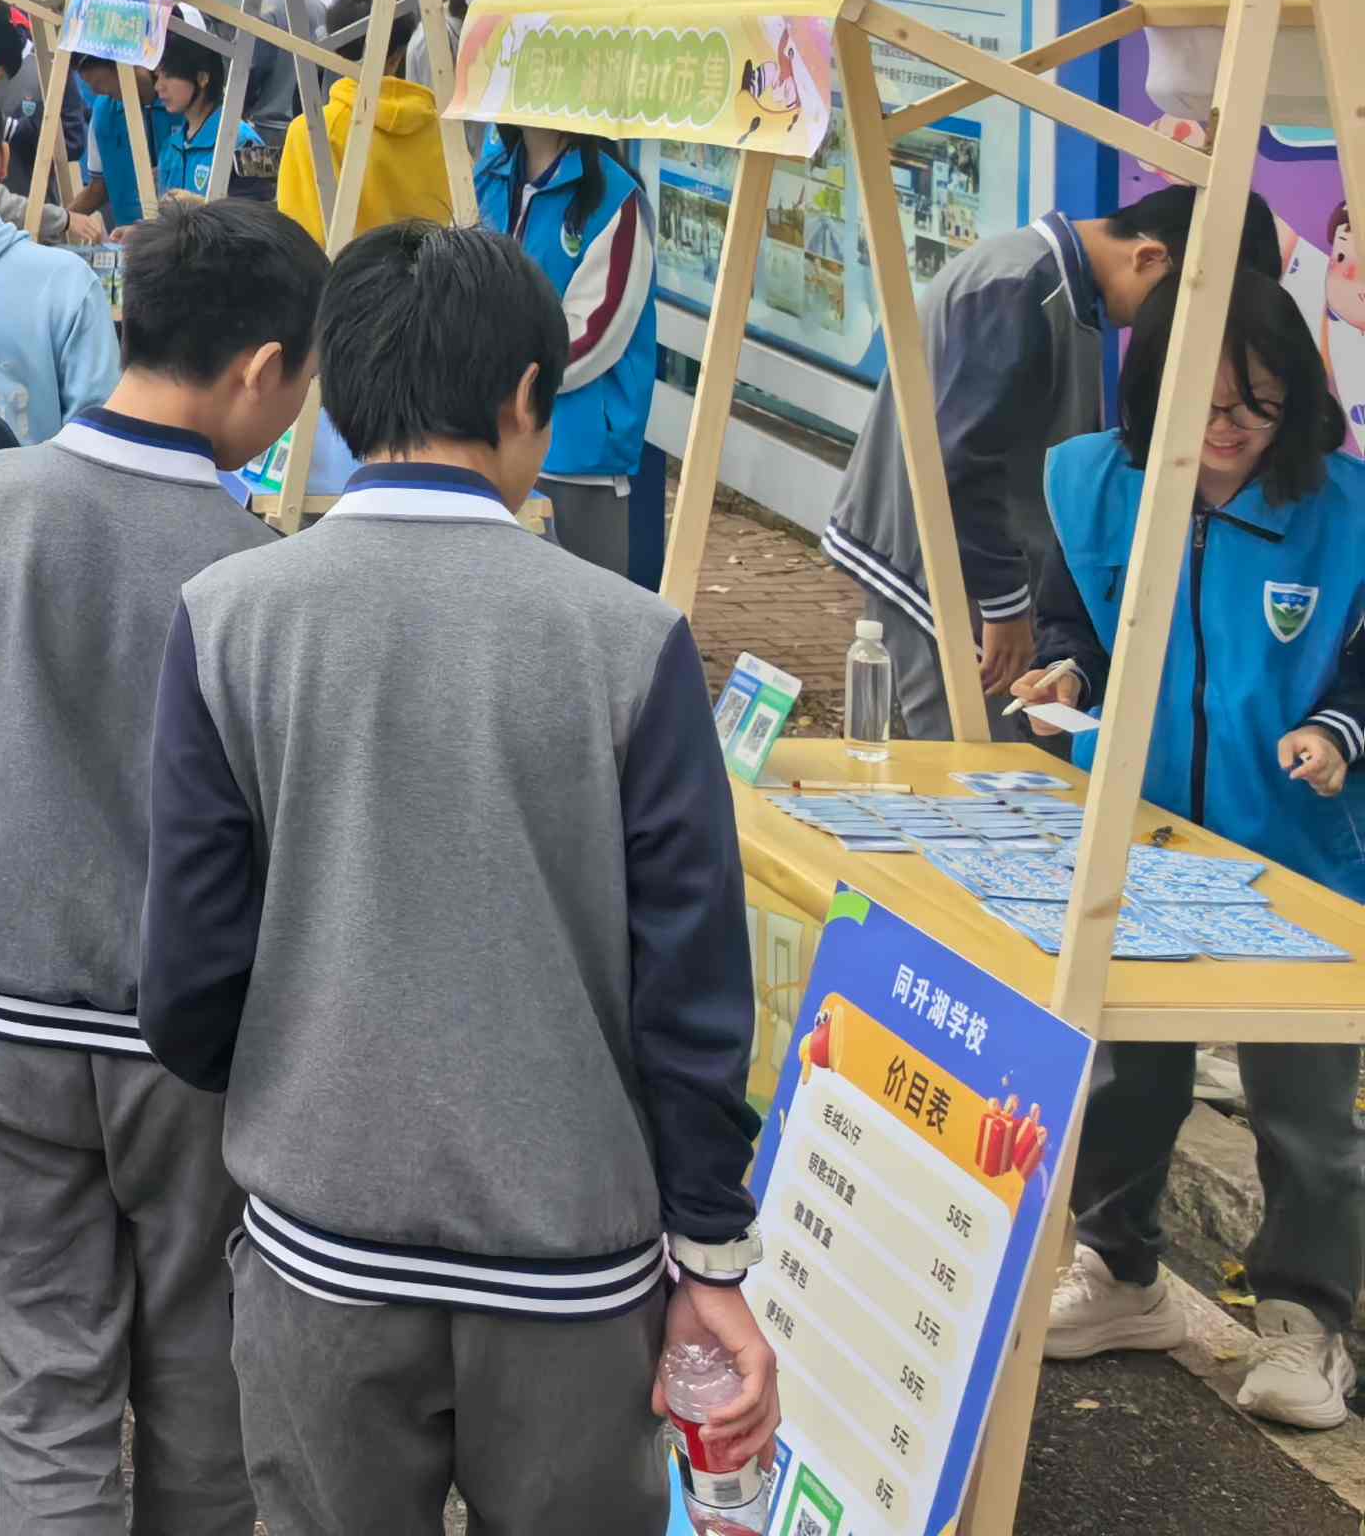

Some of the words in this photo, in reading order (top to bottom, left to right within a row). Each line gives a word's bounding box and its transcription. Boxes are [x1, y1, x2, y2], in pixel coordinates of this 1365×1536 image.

[891, 962, 990, 1057] 同升湖学校
[883, 1054, 954, 1136] 价目表
[823, 1103, 862, 1146] 毛绒公仔
[945, 1202, 974, 1239] 58元
[931, 1257, 957, 1293] 18元
[915, 1310, 942, 1347] 15元
[900, 1365, 926, 1401] 58元
[890, 1423, 911, 1456] 5元
[875, 1477, 895, 1511] 8元
